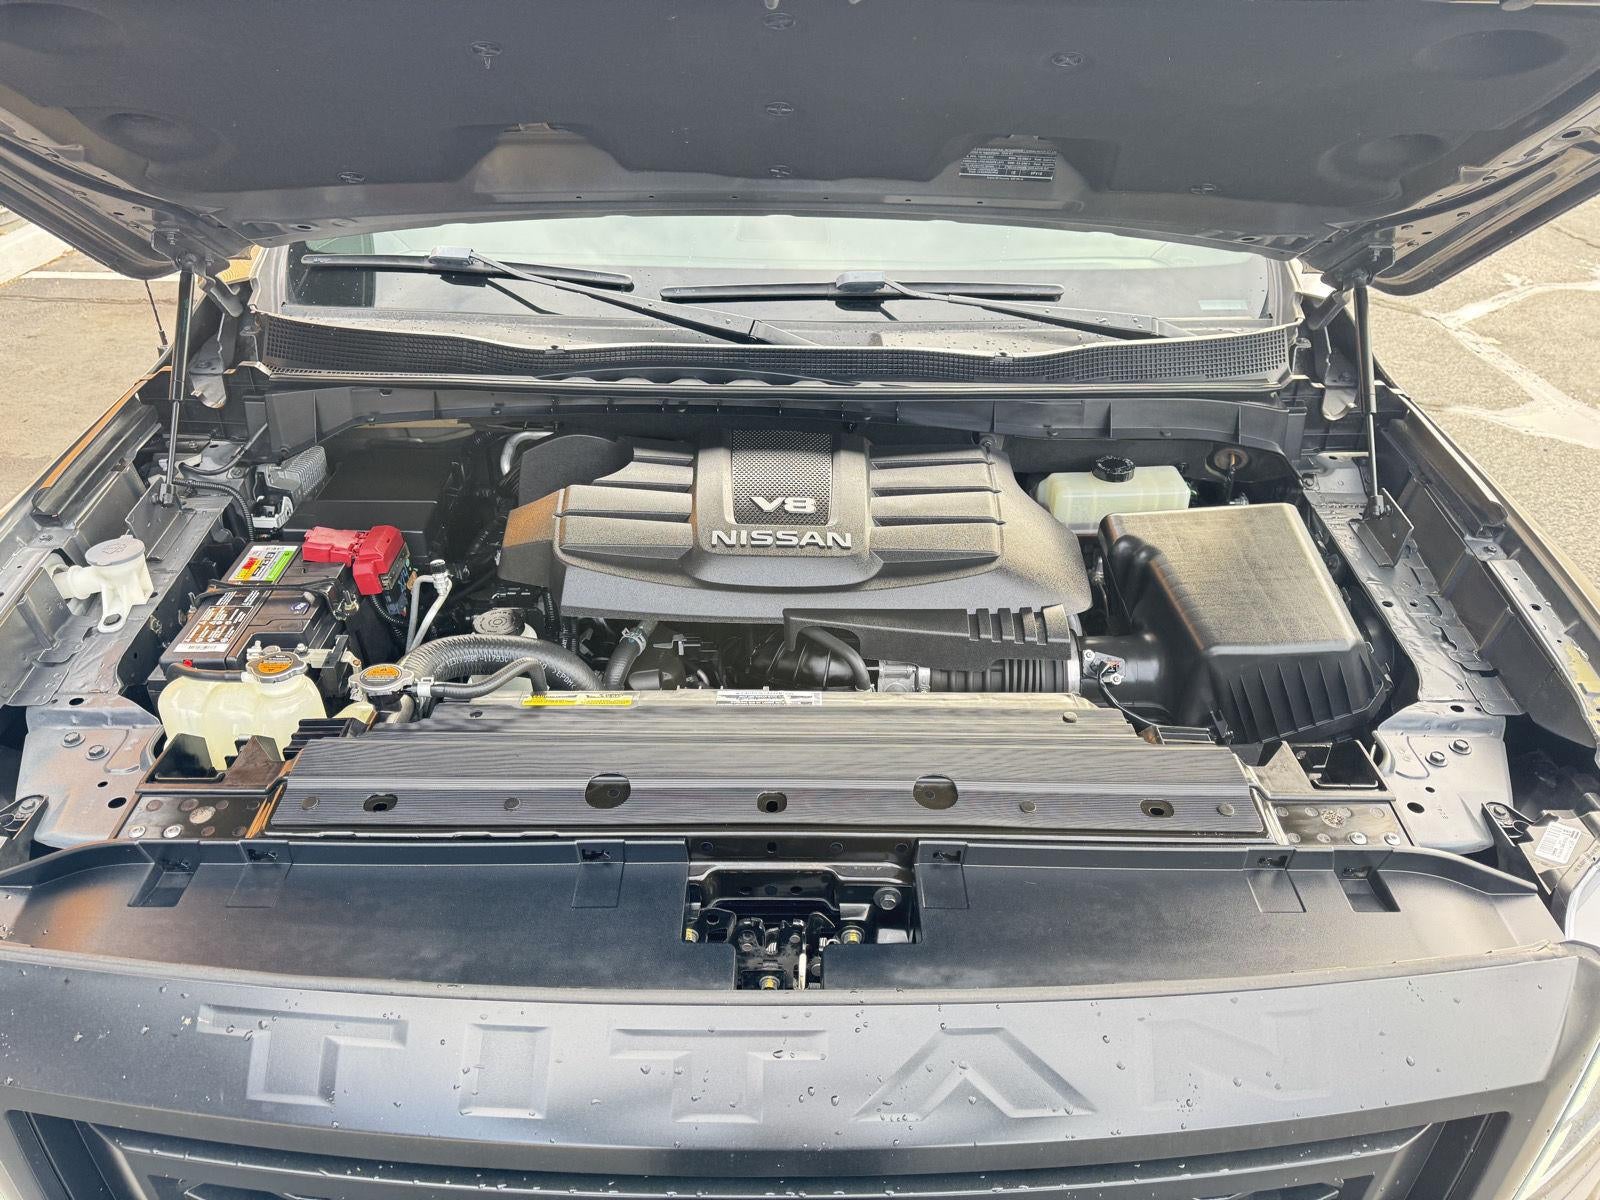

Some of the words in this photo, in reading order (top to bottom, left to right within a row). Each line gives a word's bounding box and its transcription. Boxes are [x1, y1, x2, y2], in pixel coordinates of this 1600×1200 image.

[750, 496, 817, 514] V8
[711, 529, 852, 549] NISSAN
[196, 1004, 1332, 1125] TITAN
